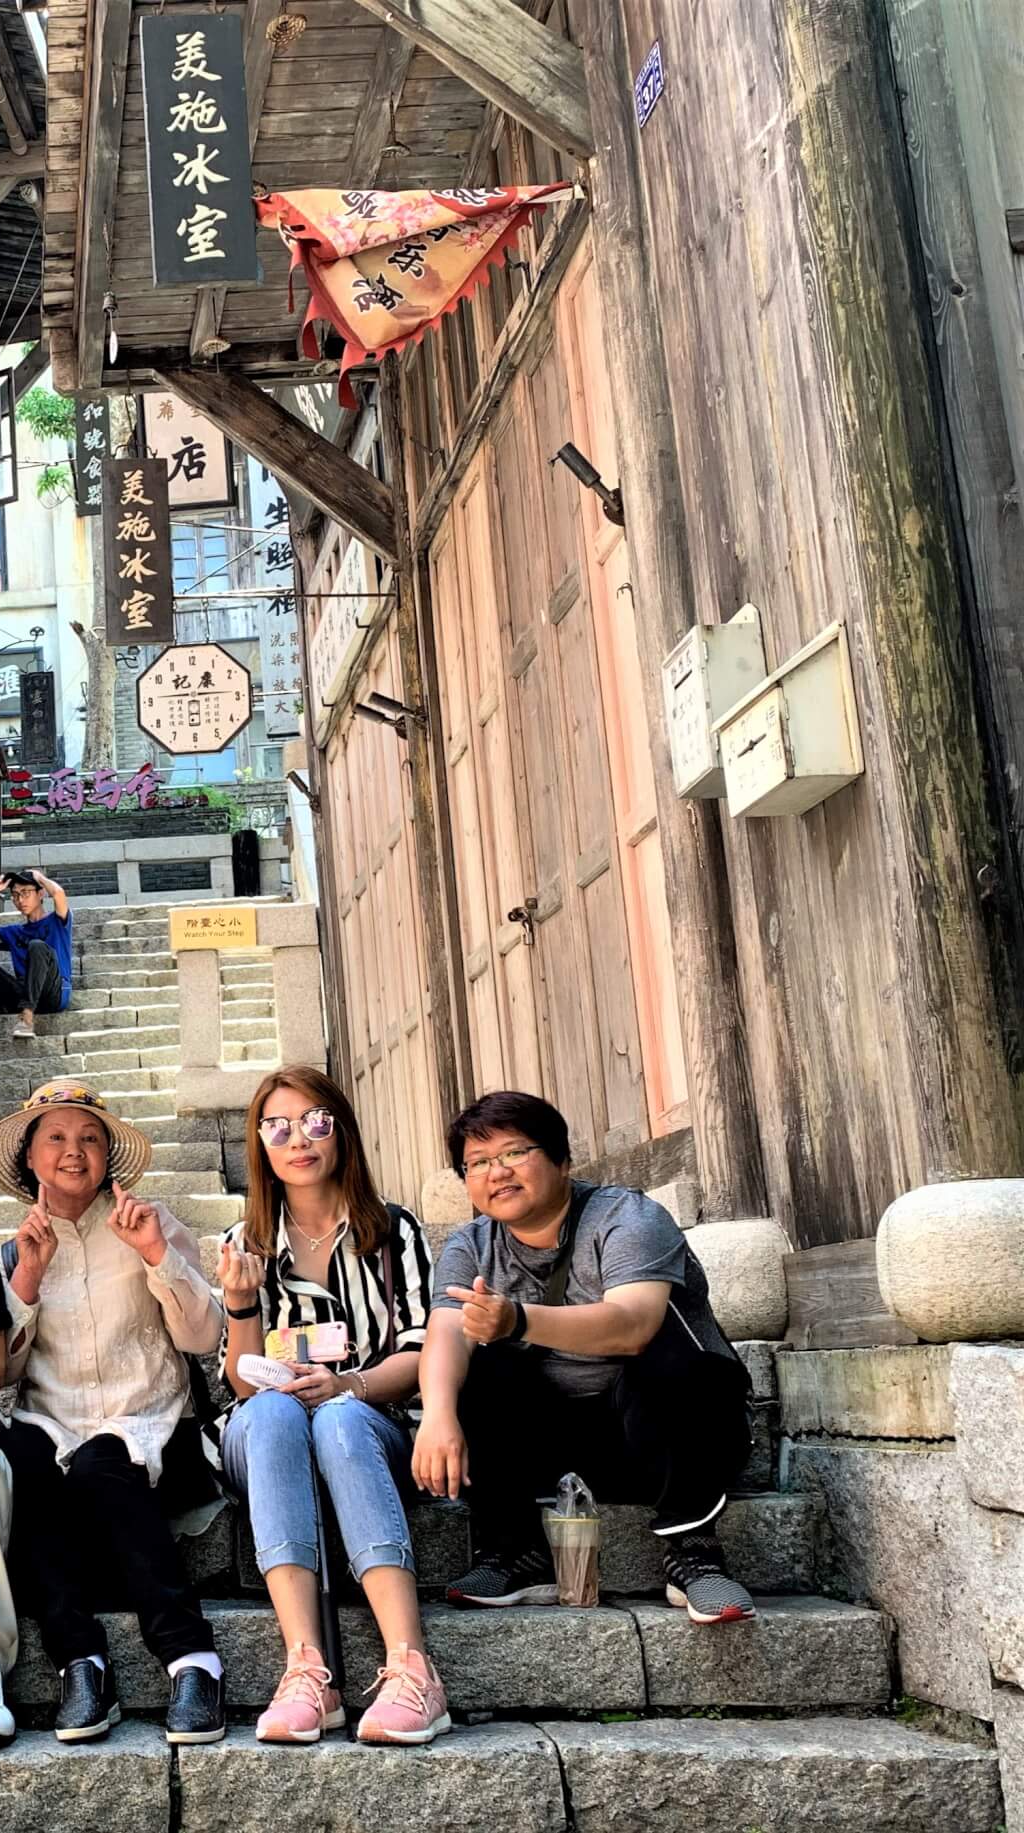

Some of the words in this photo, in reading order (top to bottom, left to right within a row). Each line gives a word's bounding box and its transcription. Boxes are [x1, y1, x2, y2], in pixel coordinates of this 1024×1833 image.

[166, 31, 231, 263] 美施冰室
[168, 435, 207, 482] 店
[115, 470, 158, 631] 美施冰室
